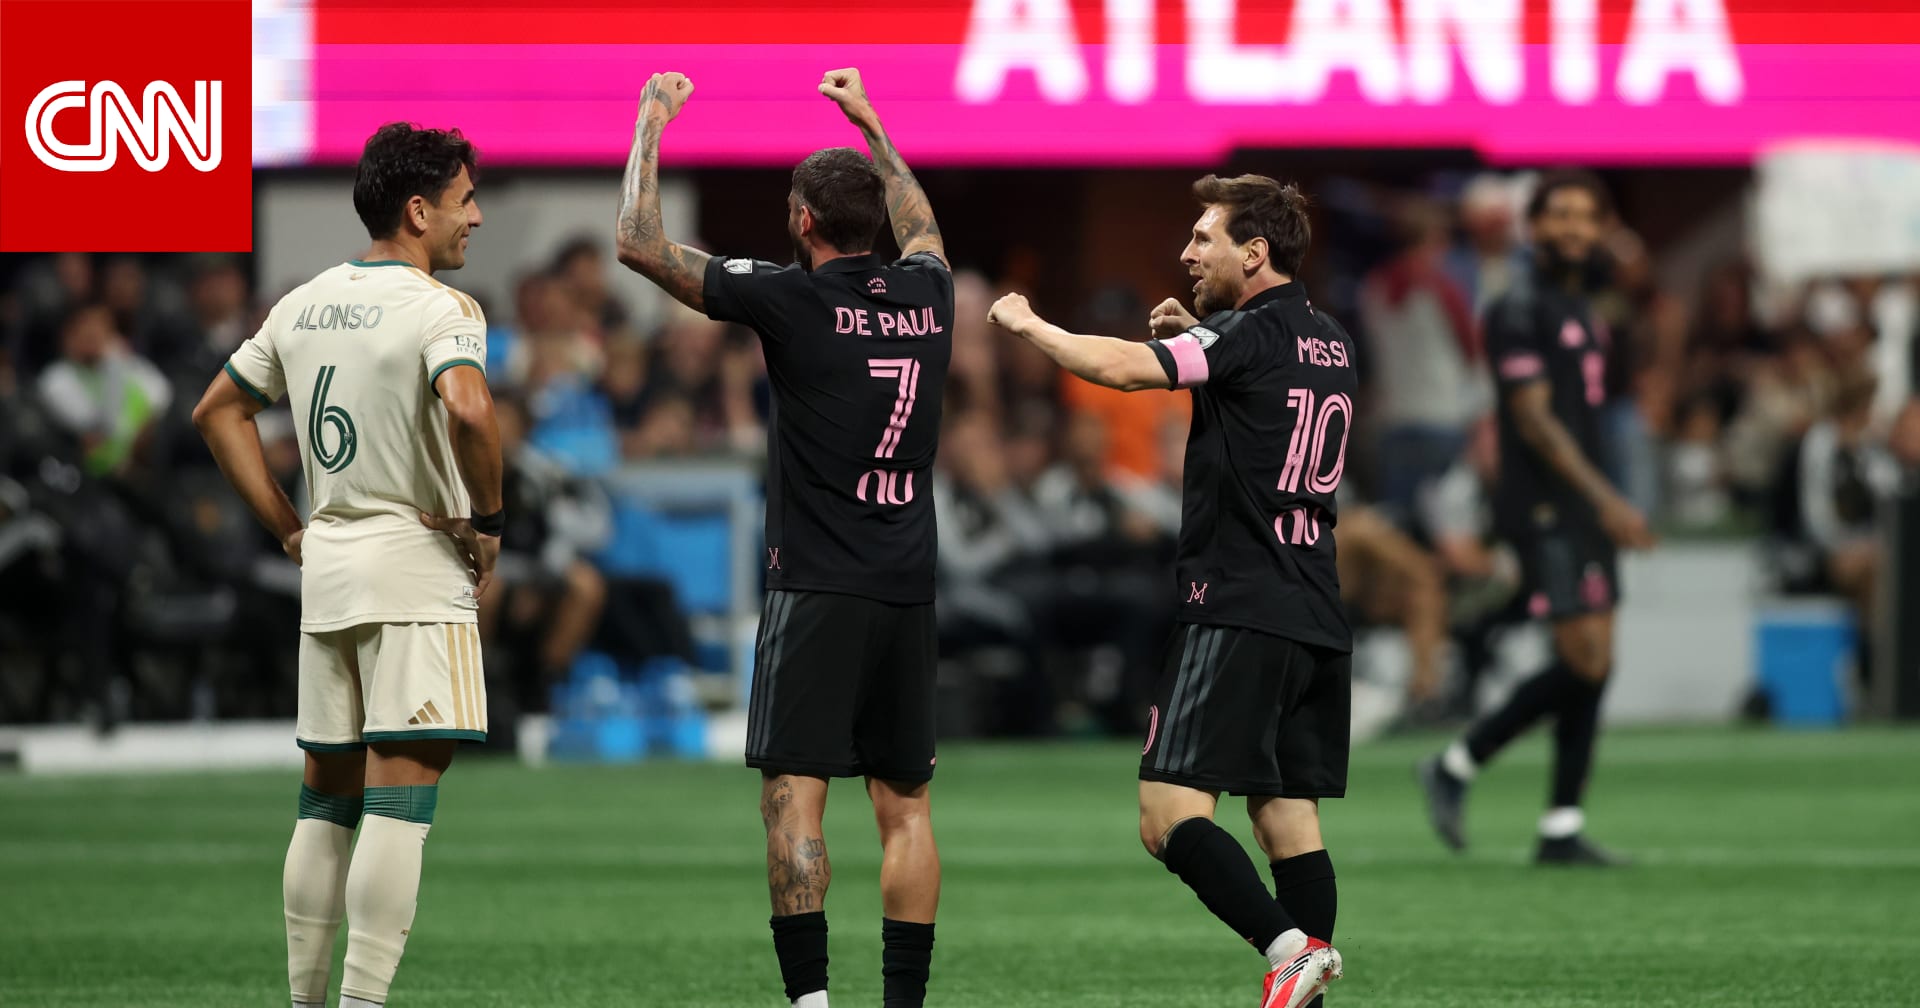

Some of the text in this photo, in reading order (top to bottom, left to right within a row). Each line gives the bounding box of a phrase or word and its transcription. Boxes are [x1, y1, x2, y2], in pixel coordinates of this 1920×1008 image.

[292, 303, 384, 332] ALONSO
[835, 306, 943, 336] DE PAUL
[1297, 335, 1350, 368] MESSI
[308, 365, 357, 475] 6
[867, 358, 921, 458] 7
[1276, 388, 1353, 494] 10
